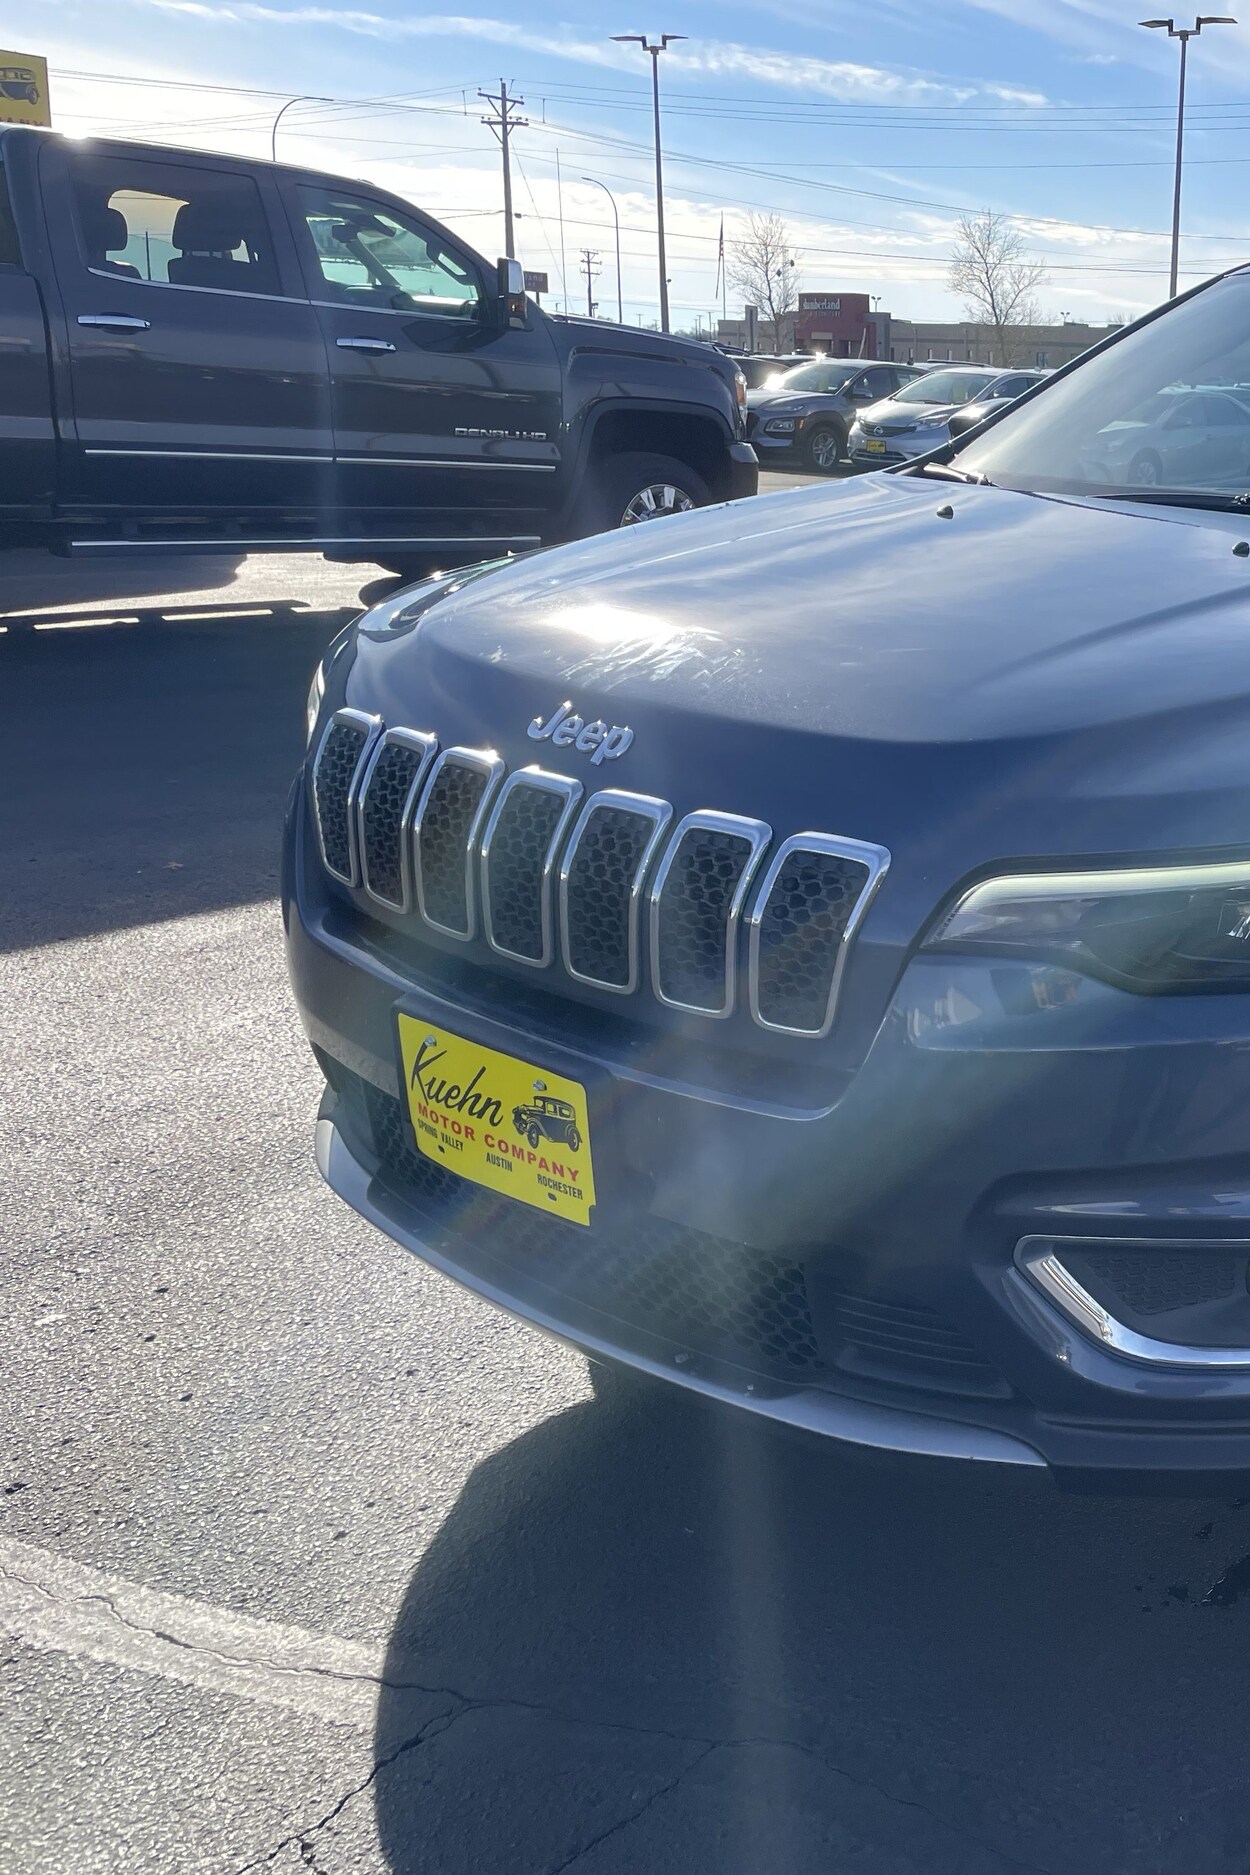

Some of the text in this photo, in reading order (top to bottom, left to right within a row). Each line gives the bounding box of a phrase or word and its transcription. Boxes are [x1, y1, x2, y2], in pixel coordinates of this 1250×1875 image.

[455, 428, 547, 440] DENALI HD
[526, 699, 634, 766] Jeep
[411, 1040, 504, 1128] Kuehn
[417, 1118, 464, 1152] SPRING VALLEY
[417, 1102, 579, 1183] MOTOR COMPANY
[486, 1152, 513, 1172] AUSTIN
[537, 1173, 583, 1201] ROCHESTER
